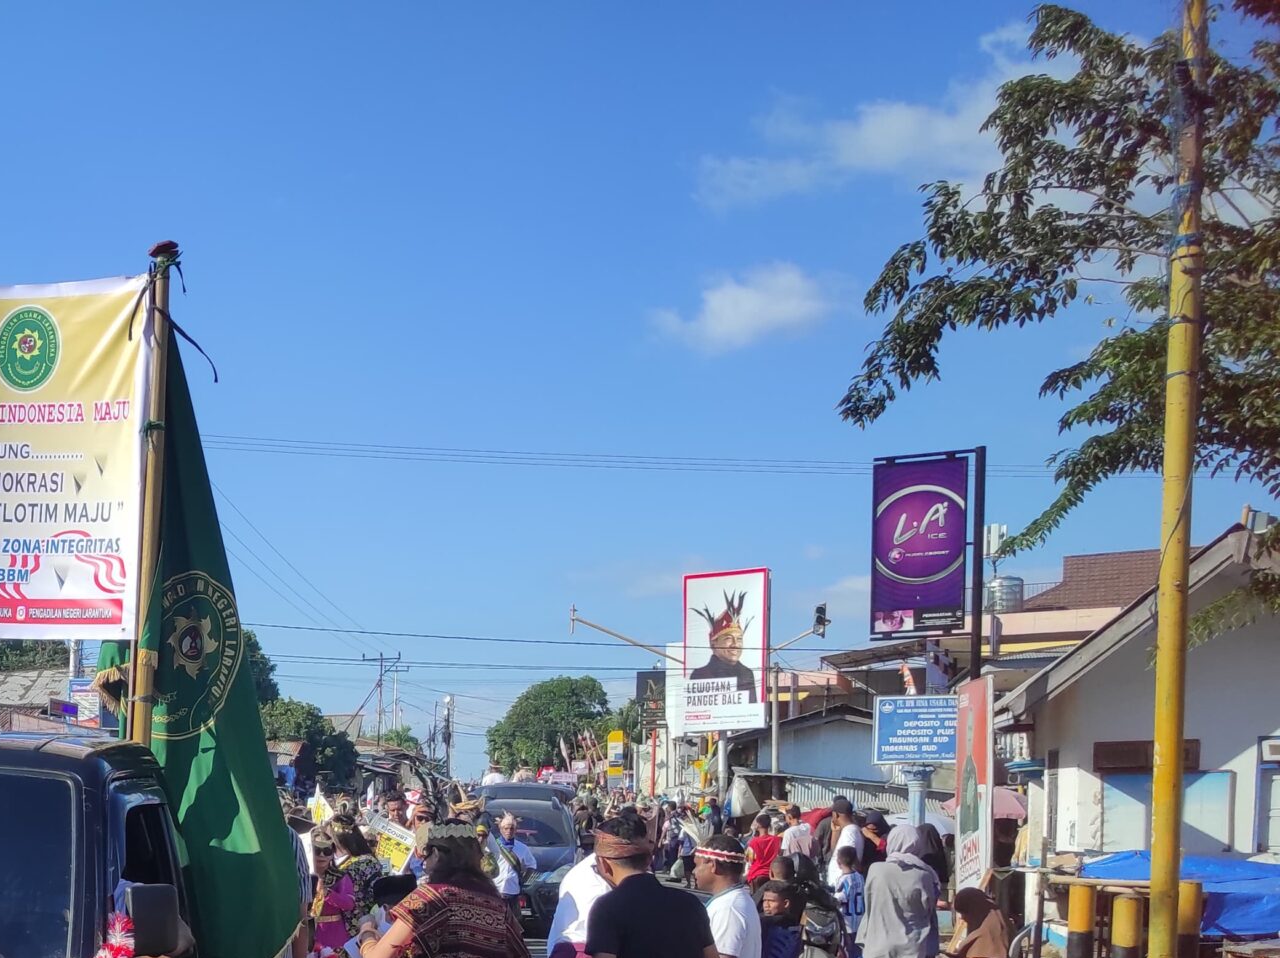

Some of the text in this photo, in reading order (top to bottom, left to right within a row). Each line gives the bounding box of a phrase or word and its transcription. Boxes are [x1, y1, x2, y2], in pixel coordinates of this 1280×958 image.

[19, 311, 42, 321] AGAMA
[93, 400, 130, 422] MAJU
[63, 502, 112, 523] MAJU
[2, 538, 42, 554] ZONA
[45, 537, 121, 555] INTEGRITAS
[28, 607, 113, 619] PENGADILAN NEGERI LARANTUKA
[686, 680, 731, 694] LEWOTANA
[686, 693, 743, 707] PANGGE BALE
[936, 728, 955, 736] PLUS
[889, 736, 930, 744] TABUNGAN
[921, 744, 938, 752] BUD
